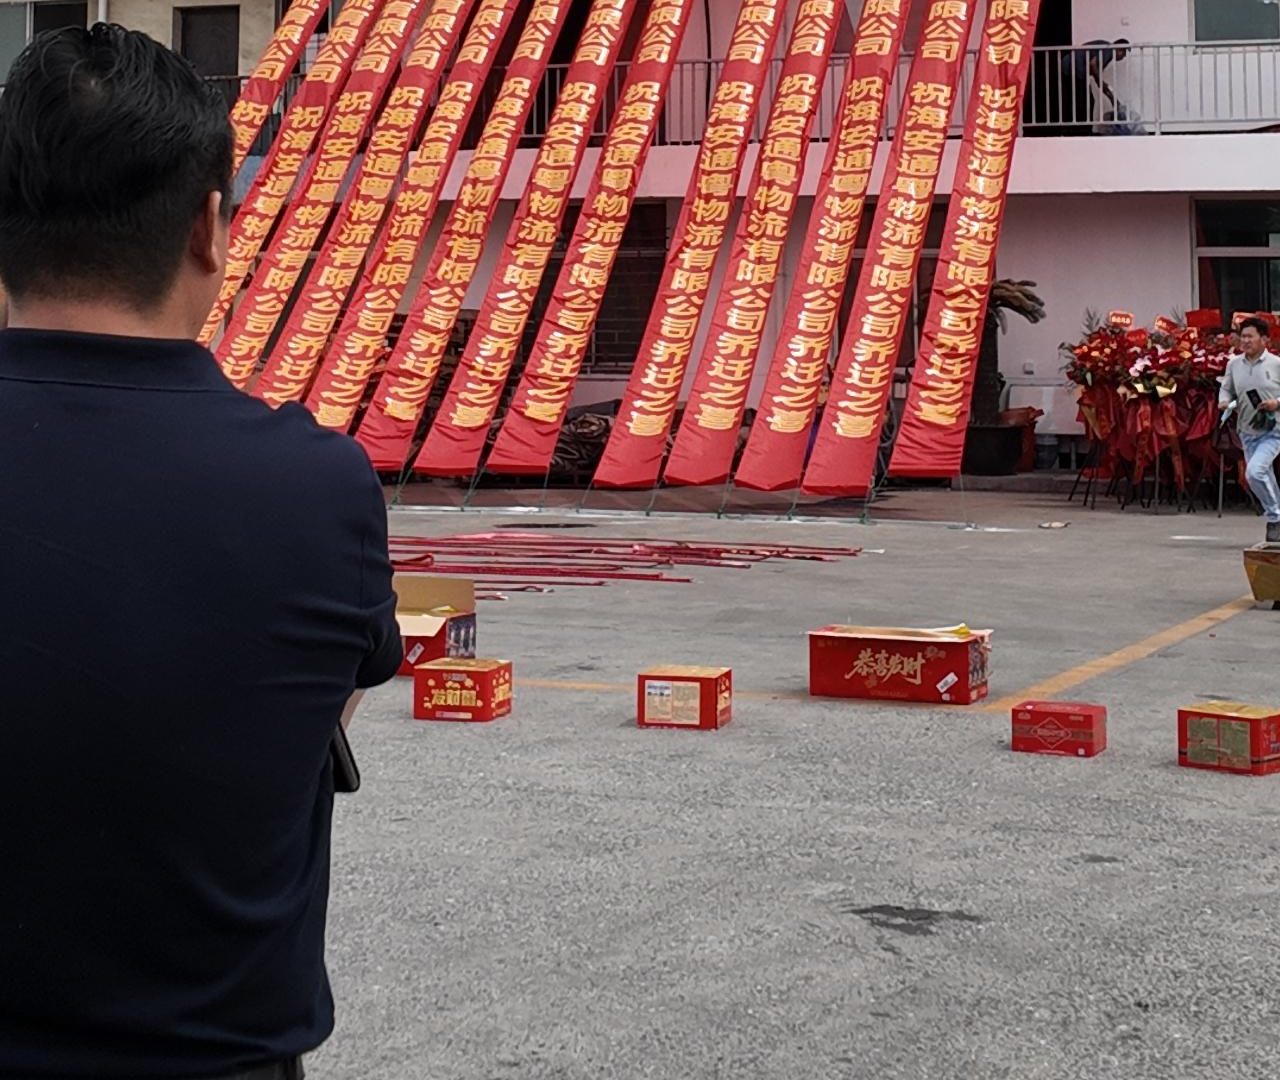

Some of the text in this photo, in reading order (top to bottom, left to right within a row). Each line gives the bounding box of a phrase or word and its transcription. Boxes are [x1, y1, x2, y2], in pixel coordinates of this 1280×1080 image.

[384, 77, 531, 421] 祝海安通粤物流有限公司乔迁之喜
[450, 81, 597, 428] 祝海安通粤物流有限公司乔迁之喜
[523, 81, 660, 423] 祝海安通粤物流有限公司乔迁之喜
[627, 81, 754, 437] 祝海安通粤物流有限公司乔迁之喜
[694, 74, 817, 431] 祝海安通粤物流有限公司乔迁之喜
[766, 76, 884, 434] 祝海安通粤物流有限公司乔迁之喜
[832, 81, 953, 438] 祝海安通粤物流有限公司乔迁之喜
[915, 83, 1018, 425] 祝海安通粤物流有限公司乔迁之喜
[844, 647, 926, 685] 恭喜发财
